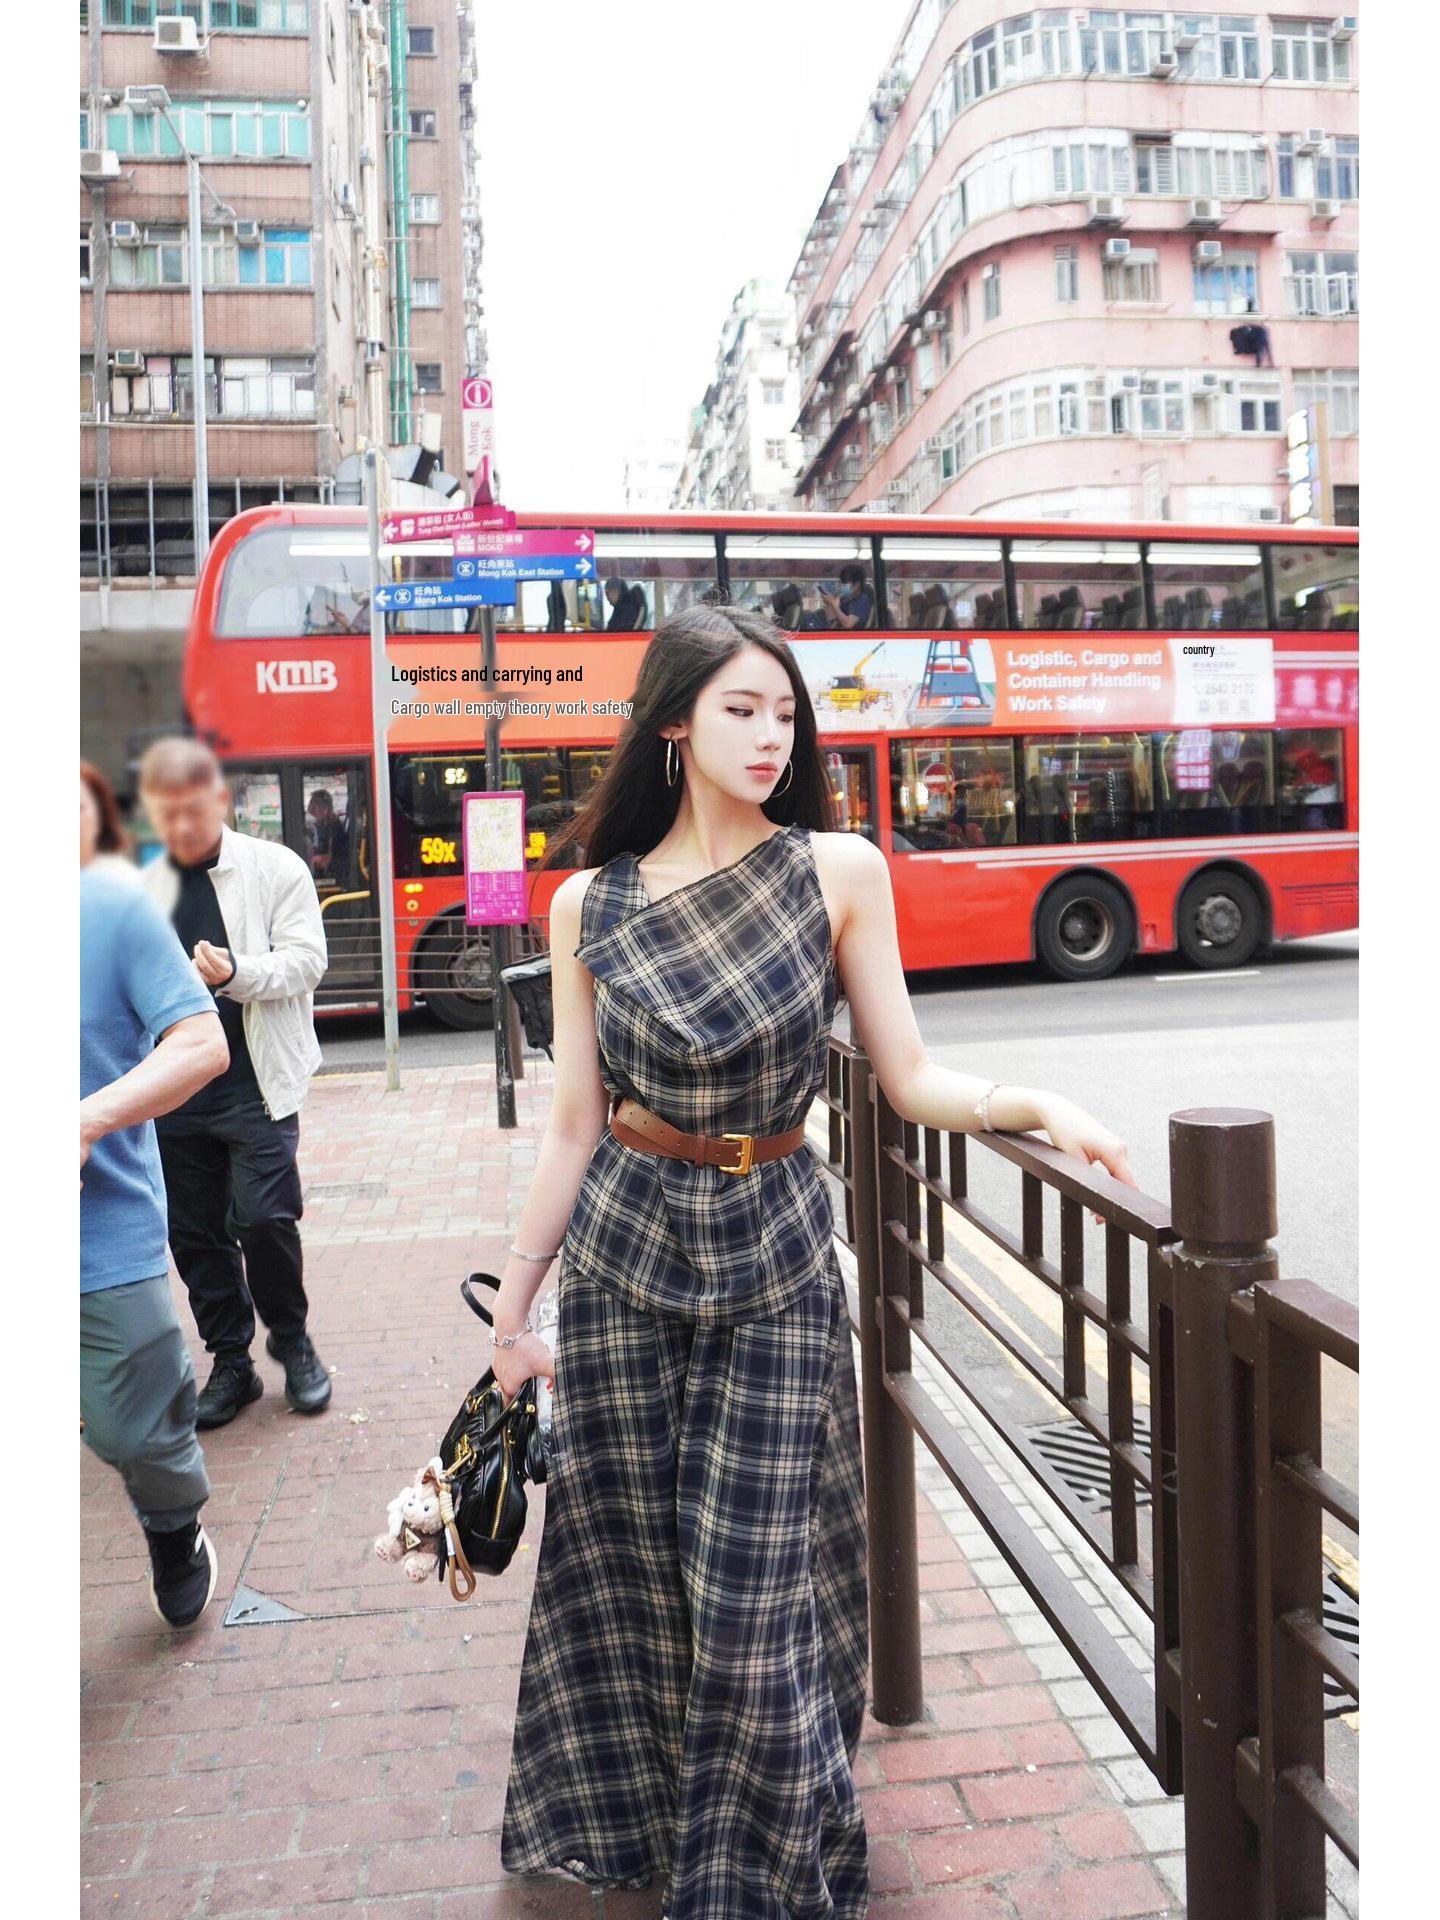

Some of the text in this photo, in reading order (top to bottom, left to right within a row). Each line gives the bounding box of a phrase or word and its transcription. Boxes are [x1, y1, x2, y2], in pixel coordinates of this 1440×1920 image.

[468, 421, 480, 455] Mong
[482, 426, 492, 450] Kok
[478, 543, 503, 551] MOKO
[478, 570, 499, 578] Mong
[415, 597, 436, 605] Mong
[1007, 650, 1162, 670] Logistic, Cargo and
[256, 660, 338, 694] KMB
[1008, 671, 1162, 690] Container Handling
[1008, 694, 1107, 714] Work Safety
